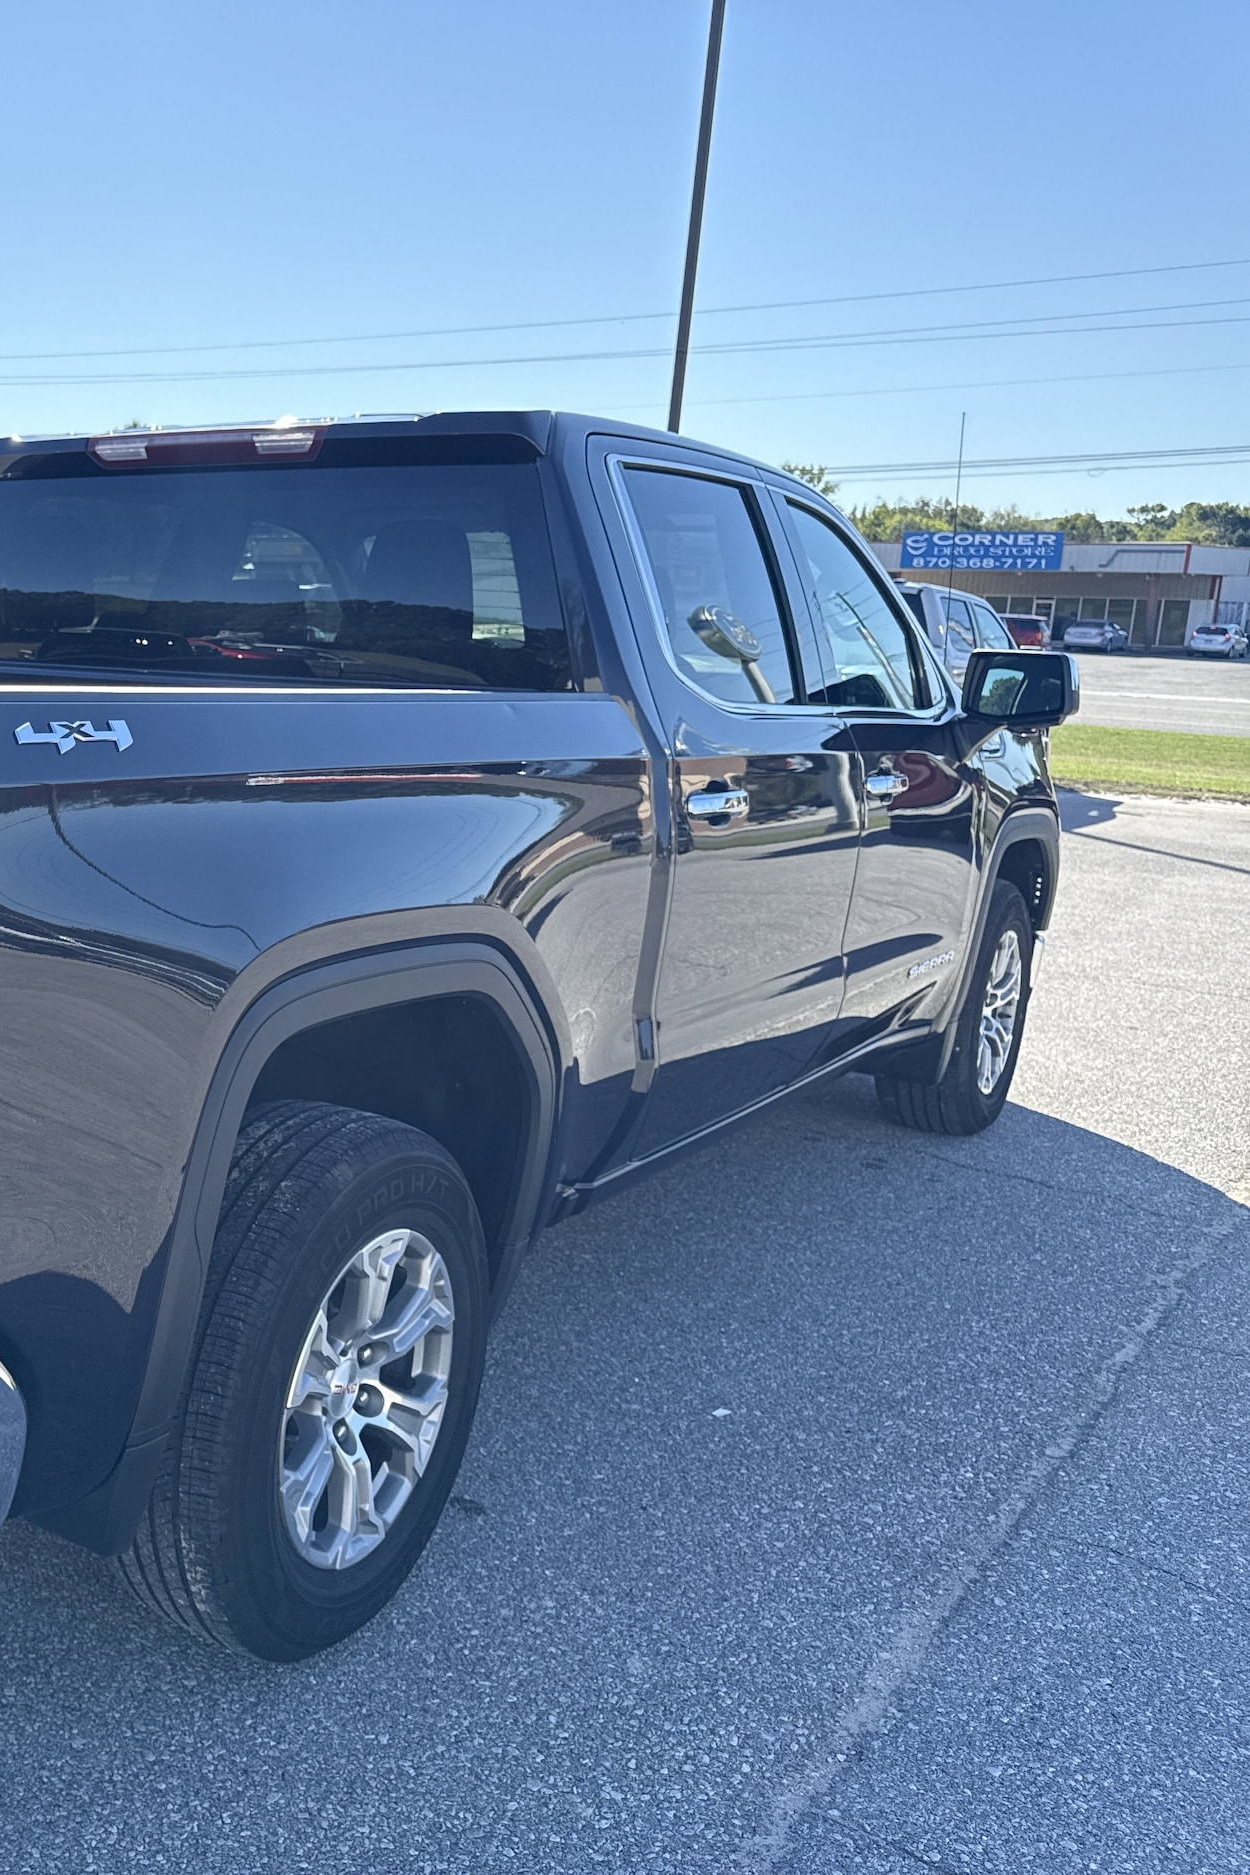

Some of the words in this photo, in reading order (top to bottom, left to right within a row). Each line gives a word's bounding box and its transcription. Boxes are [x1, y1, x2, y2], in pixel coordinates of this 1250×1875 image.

[932, 532, 1057, 546] CORNER
[933, 546, 984, 556] DRUG
[989, 546, 1055, 557] STORE
[912, 557, 1047, 570] 870-368-7171
[908, 949, 955, 979] SIERRA
[356, 1177, 405, 1227] PRO
